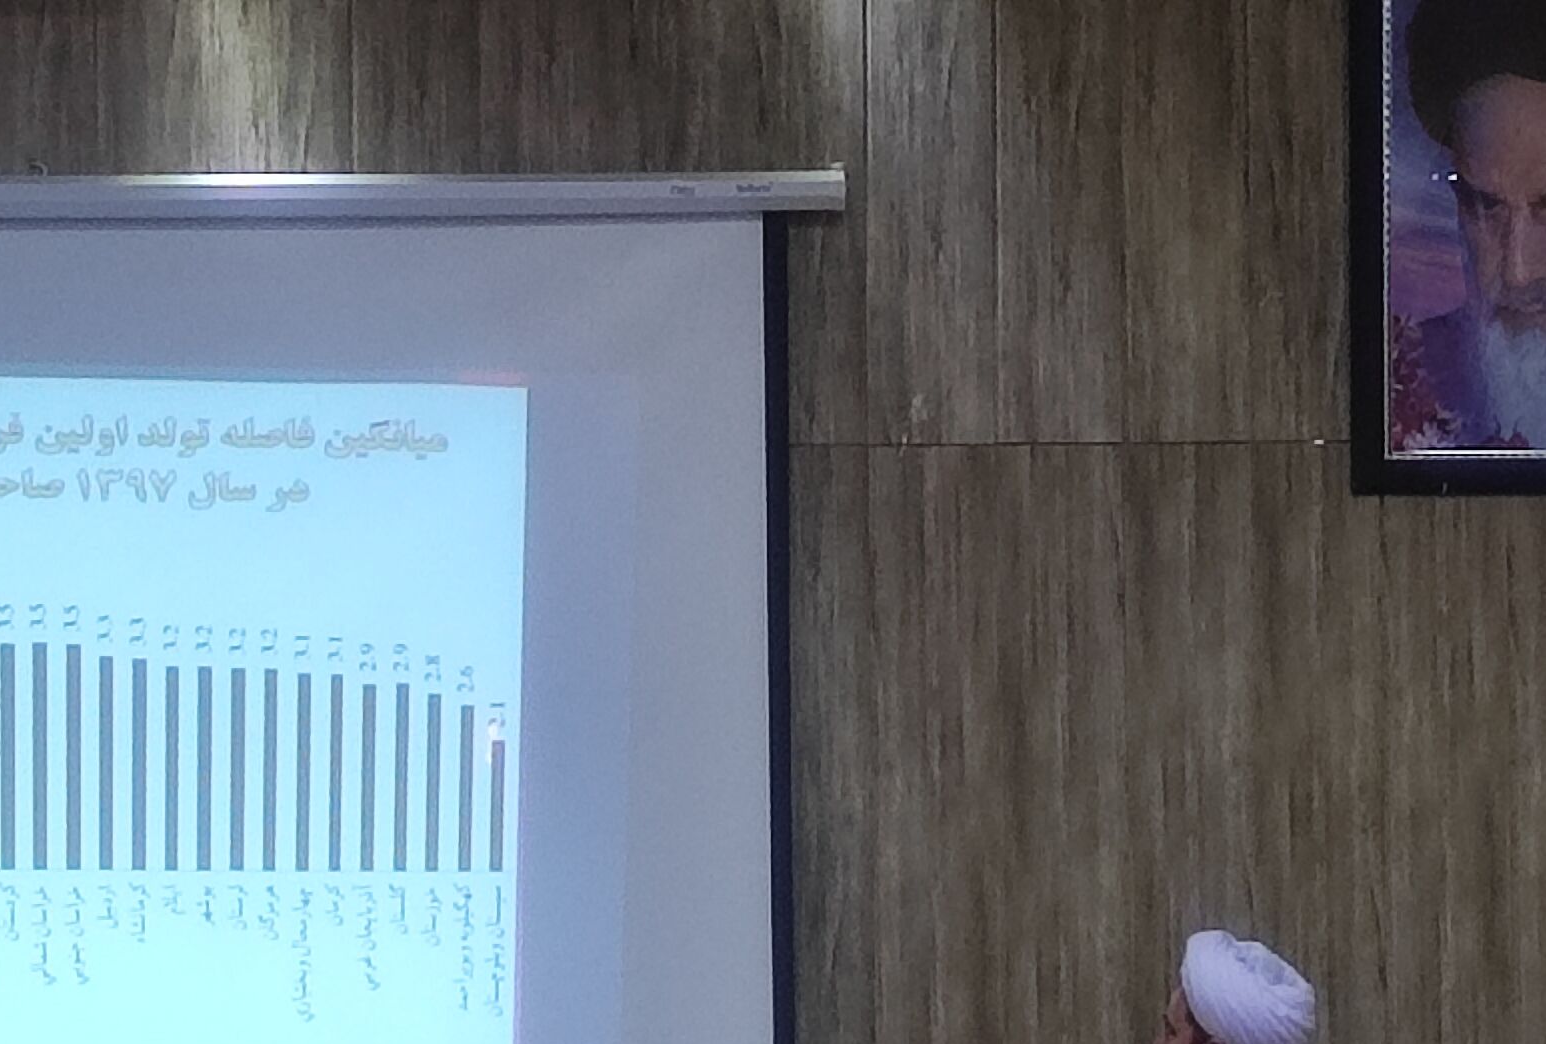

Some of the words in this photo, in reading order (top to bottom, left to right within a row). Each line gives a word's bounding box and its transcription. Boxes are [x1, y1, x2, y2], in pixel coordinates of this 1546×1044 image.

[35, 414, 127, 457] اولین
[137, 417, 210, 458] تولد
[220, 416, 315, 449] فاصله
[325, 419, 448, 459] میانگین
[75, 468, 178, 503] ۱۳۹۷
[188, 471, 256, 510] سال
[265, 478, 310, 512] در
